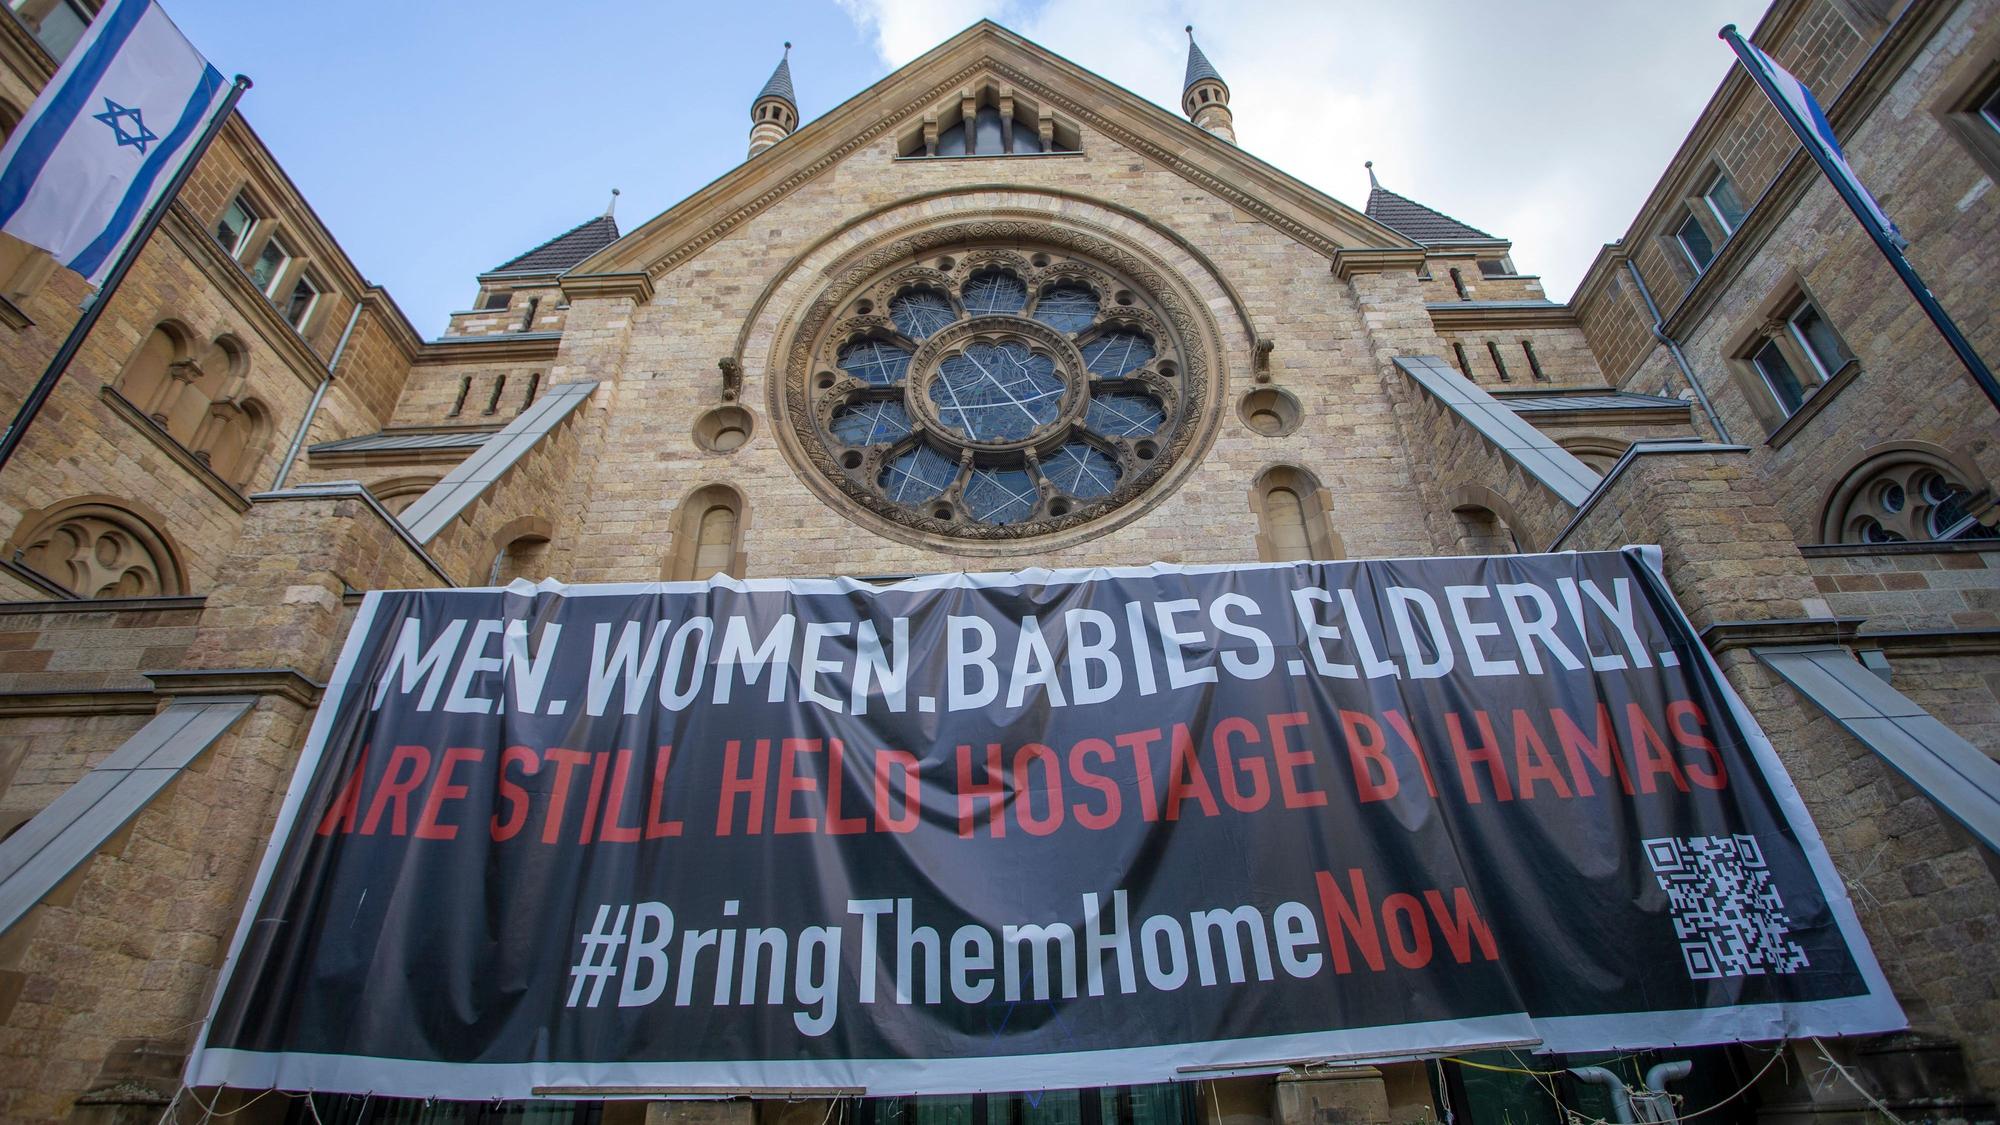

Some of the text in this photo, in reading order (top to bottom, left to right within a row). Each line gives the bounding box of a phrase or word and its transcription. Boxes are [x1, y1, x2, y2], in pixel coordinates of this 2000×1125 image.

[316, 700, 1728, 845] ARE STILL HELD HOSTAGE BY HAMAS
[566, 868, 1500, 1037] #BringThemHomeNow
